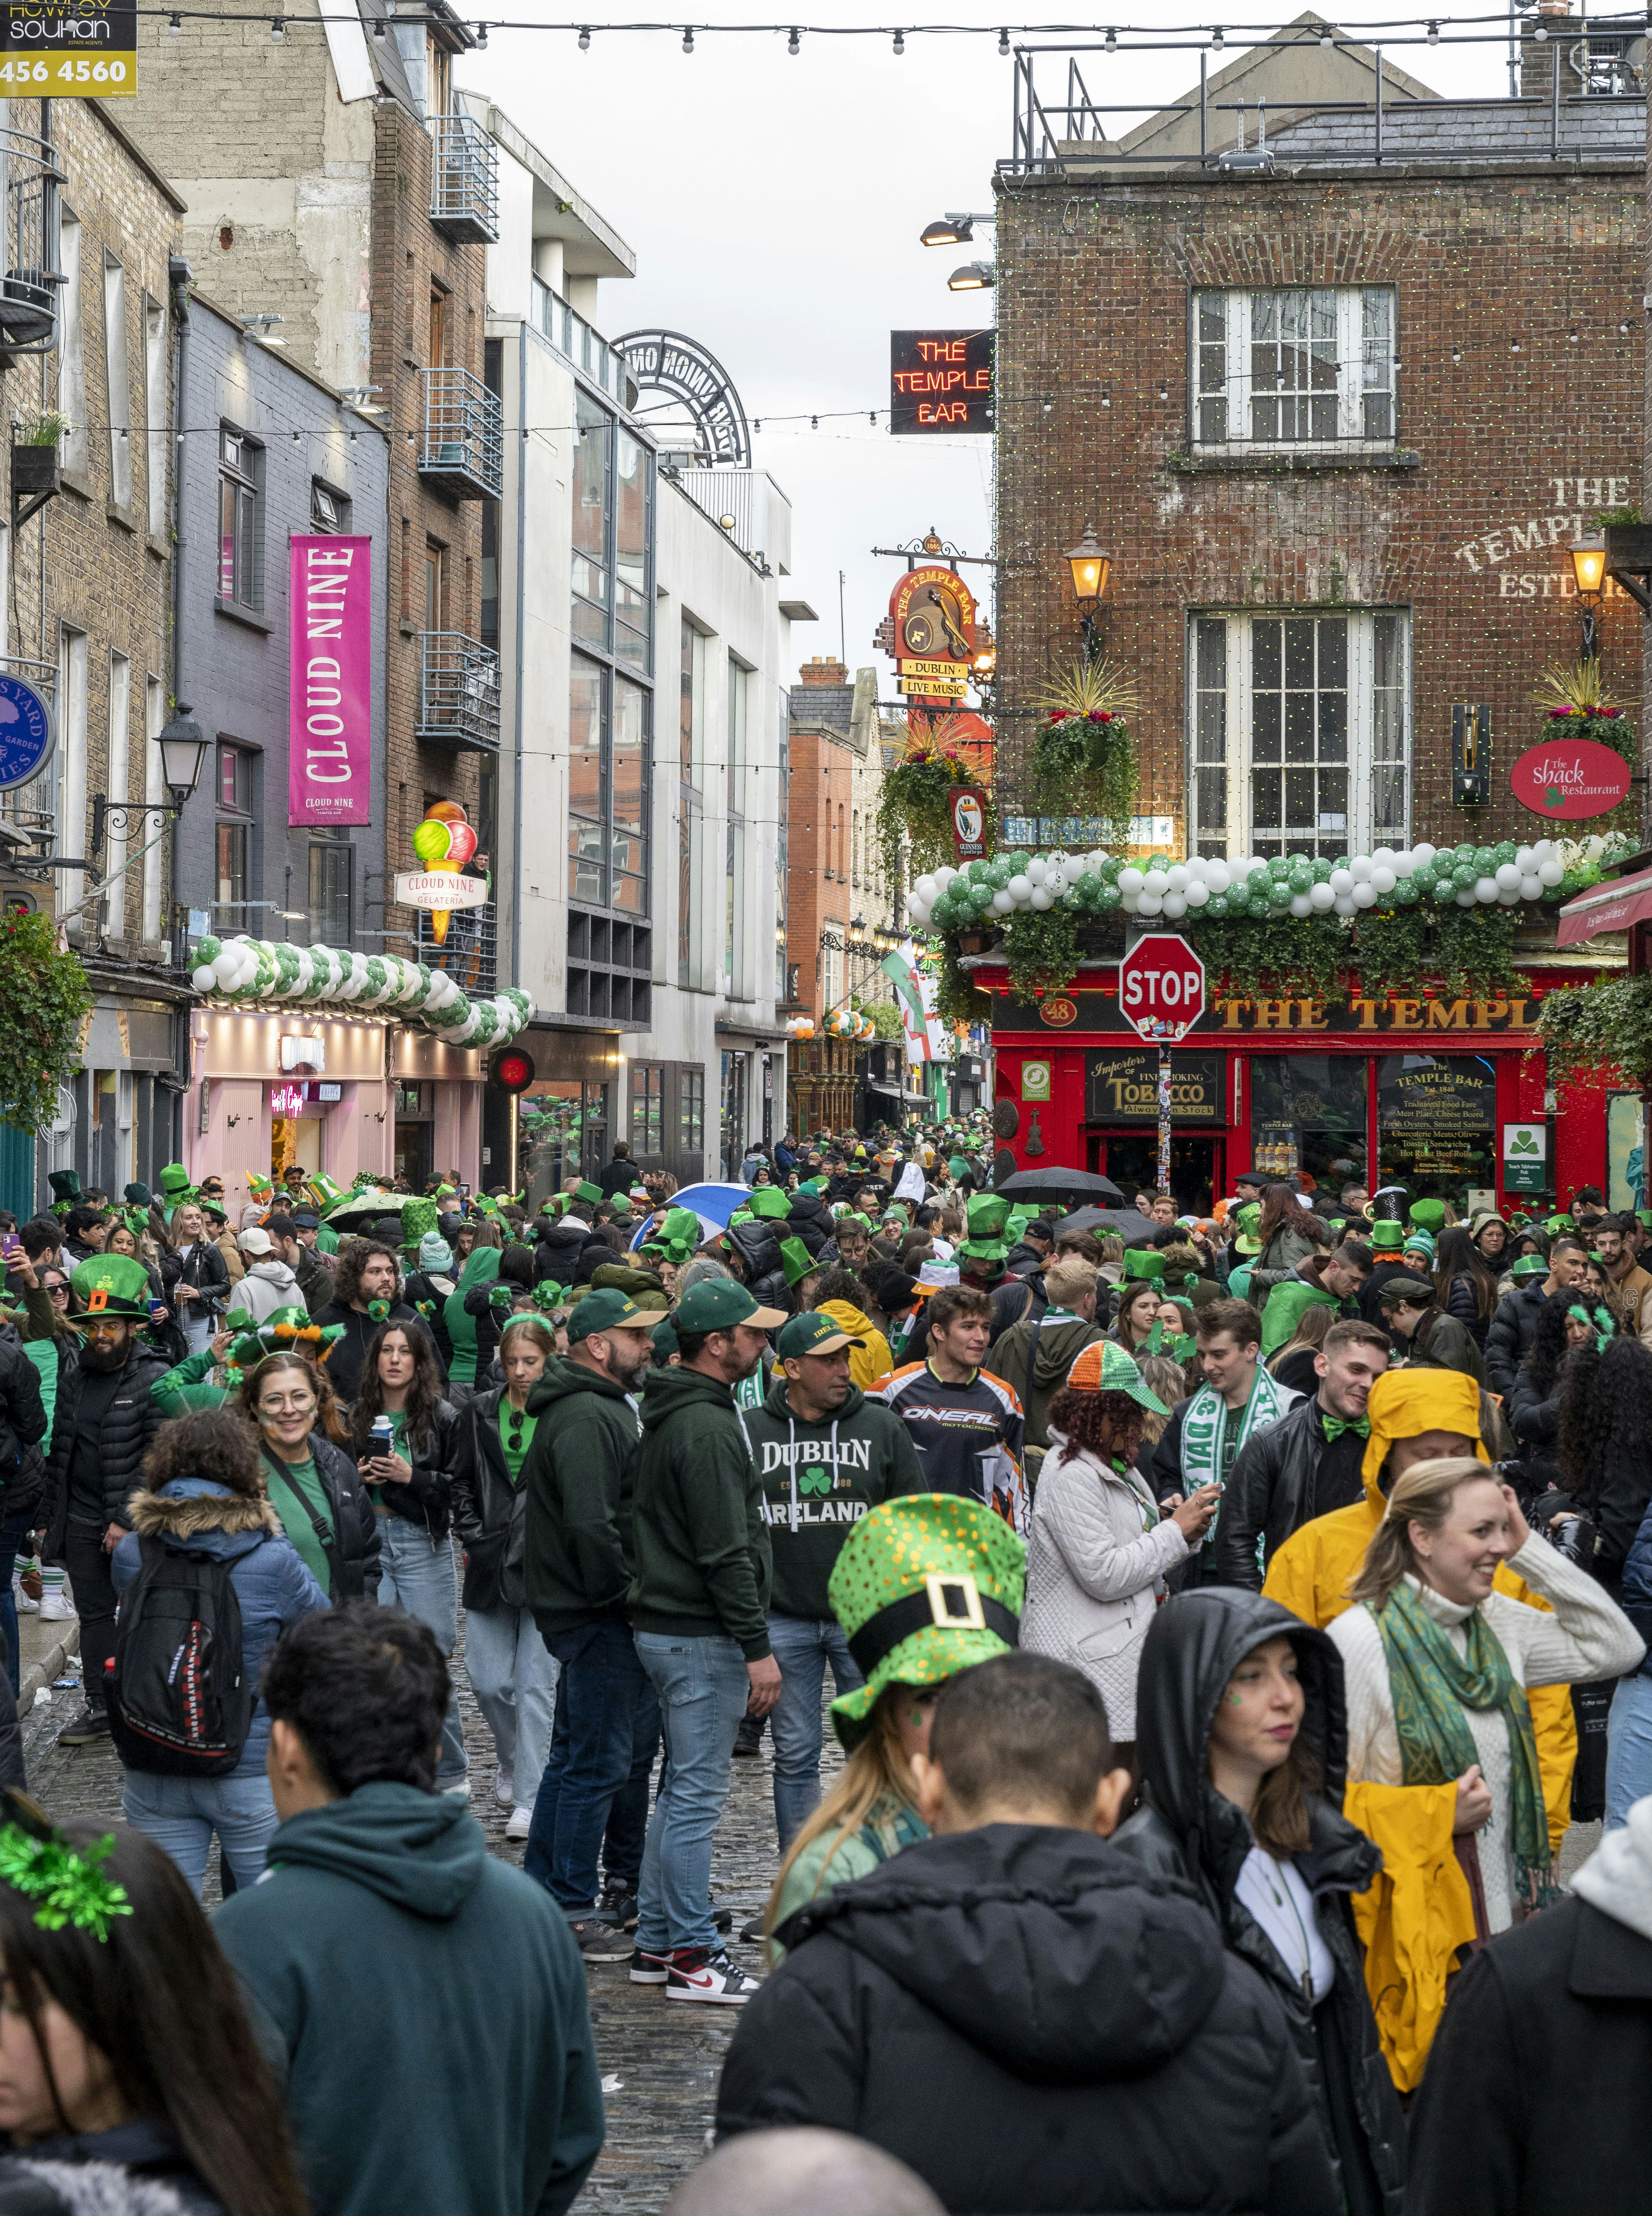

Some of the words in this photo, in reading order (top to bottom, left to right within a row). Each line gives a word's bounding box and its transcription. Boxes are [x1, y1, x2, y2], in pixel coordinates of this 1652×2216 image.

[0, 61, 48, 82] 456
[57, 61, 126, 82] 4560
[917, 341, 966, 362] THE
[893, 370, 991, 393] TEMPLE
[1549, 478, 1630, 506] THE
[1453, 514, 1606, 573] TEMPL
[307, 548, 354, 639] NINE
[898, 587, 912, 620] THE
[910, 570, 960, 592] TEMPLE
[957, 590, 973, 626] BAR
[915, 663, 955, 675] DUBLIN
[907, 682, 929, 694] LIVE
[932, 683, 963, 695] MUSIC
[306, 656, 352, 783] CLOUD
[5, 735, 39, 751] GARDEN
[1533, 759, 1585, 787] Shack
[1551, 758, 1567, 769] The
[1561, 785, 1620, 795] Restaurant
[305, 798, 332, 808] CLOUD
[334, 798, 353, 808] NINE
[408, 877, 444, 891] CLOUD
[449, 879, 474, 893] NINE
[418, 896, 463, 905] GELATERIA
[1125, 971, 1200, 1005] STOP
[1049, 1001, 1069, 1020] 48
[1215, 999, 1328, 1030] THE
[1091, 1056, 1145, 1077] Importers
[1396, 1073, 1451, 1087] TEMPLE
[1456, 1075, 1483, 1088] BAR
[1182, 1106, 1212, 1114] Stock
[1623, 1288, 1638, 1309] G
[762, 1438, 872, 1474] DUBLIN
[757, 1502, 868, 1525] IRELAND
